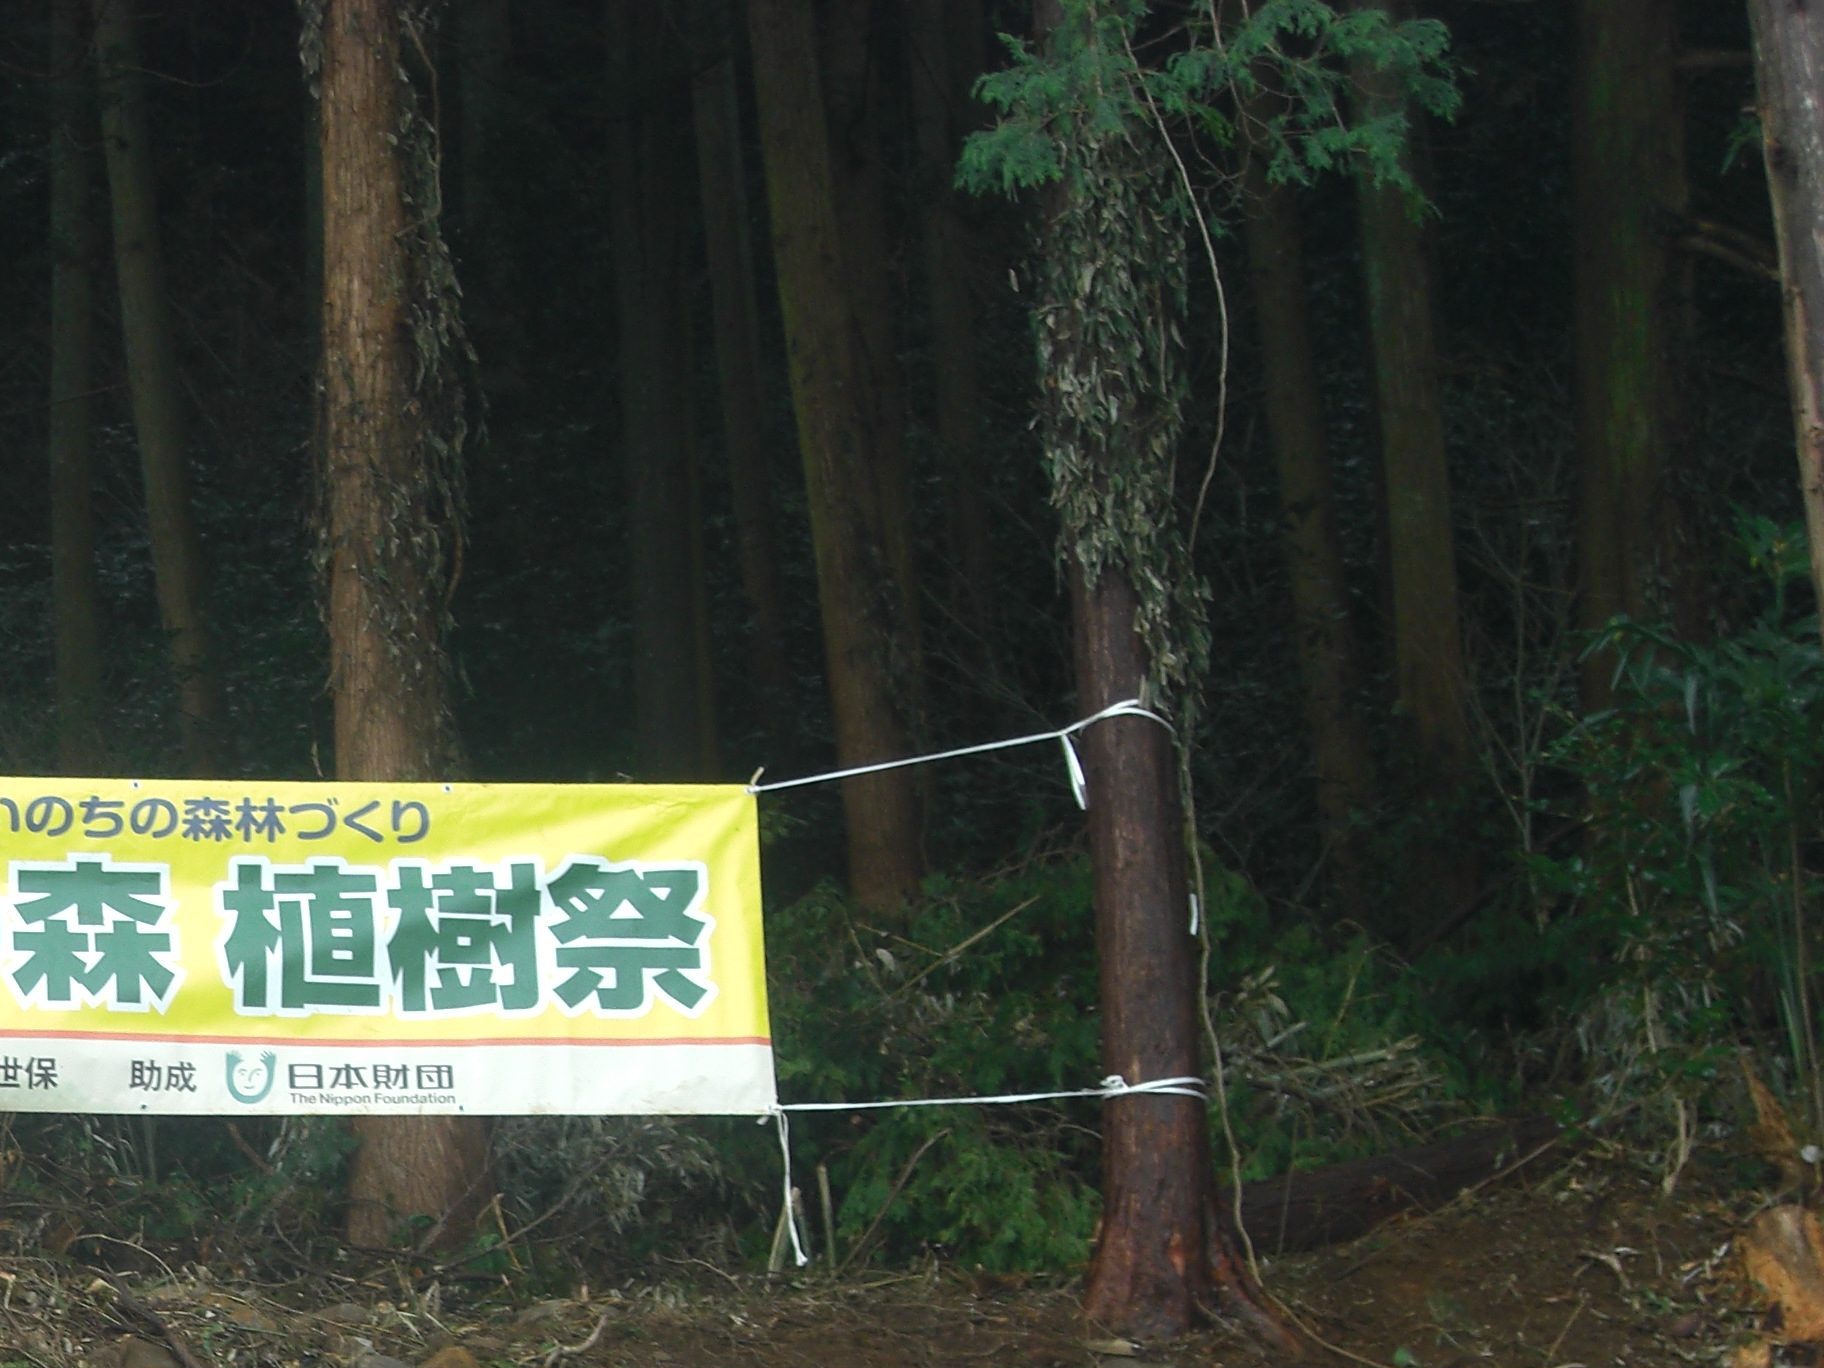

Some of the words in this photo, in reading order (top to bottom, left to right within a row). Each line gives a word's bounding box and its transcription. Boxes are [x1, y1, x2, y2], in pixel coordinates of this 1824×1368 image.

[221, 860, 710, 1013] 植樹祭
[129, 1059, 197, 1092] 助成
[288, 1063, 455, 1090] 日本財団
[290, 1092, 317, 1104] The
[320, 1092, 371, 1106] Nippon
[375, 1092, 456, 1105] Foundation
